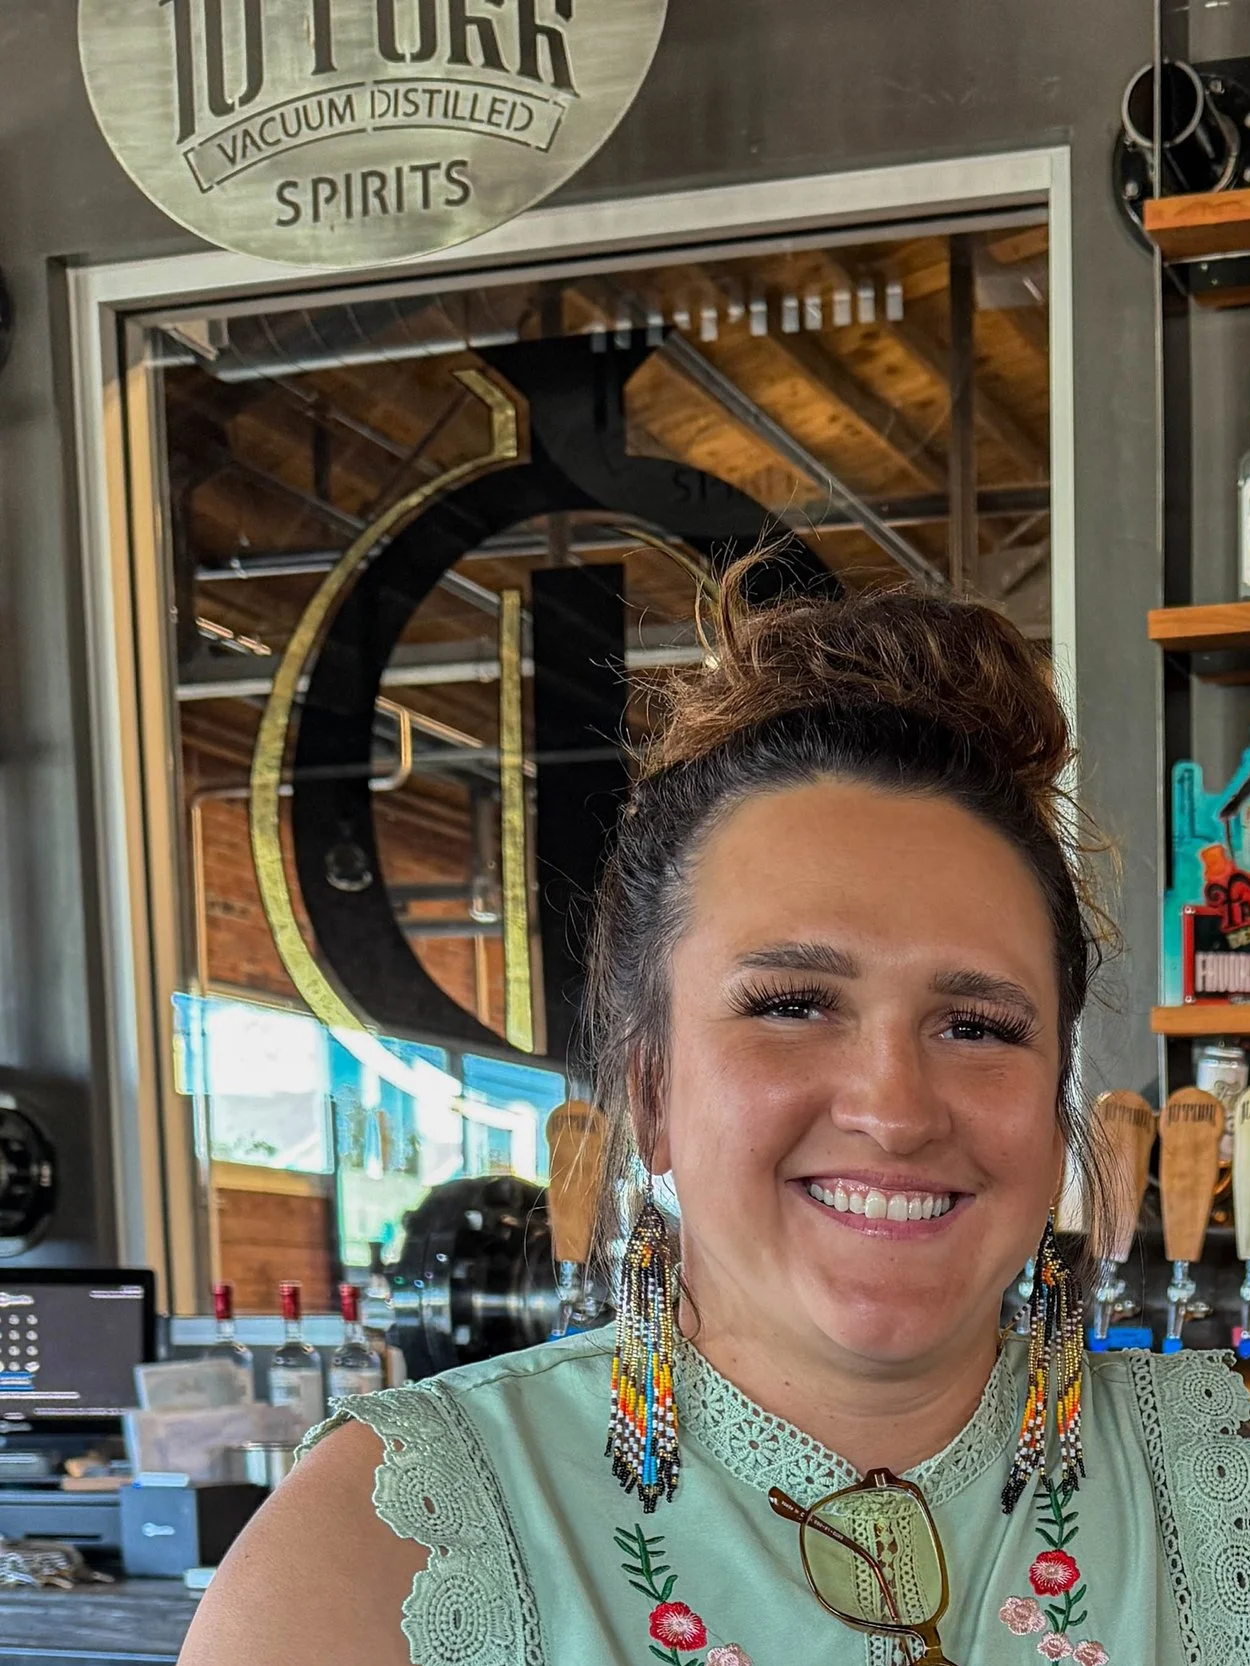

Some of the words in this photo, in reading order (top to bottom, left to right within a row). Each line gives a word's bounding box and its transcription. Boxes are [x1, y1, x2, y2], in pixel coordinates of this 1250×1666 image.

[216, 94, 357, 167] VACUUM
[369, 86, 534, 133] DISTILLED
[275, 158, 472, 228] SPIRITS
